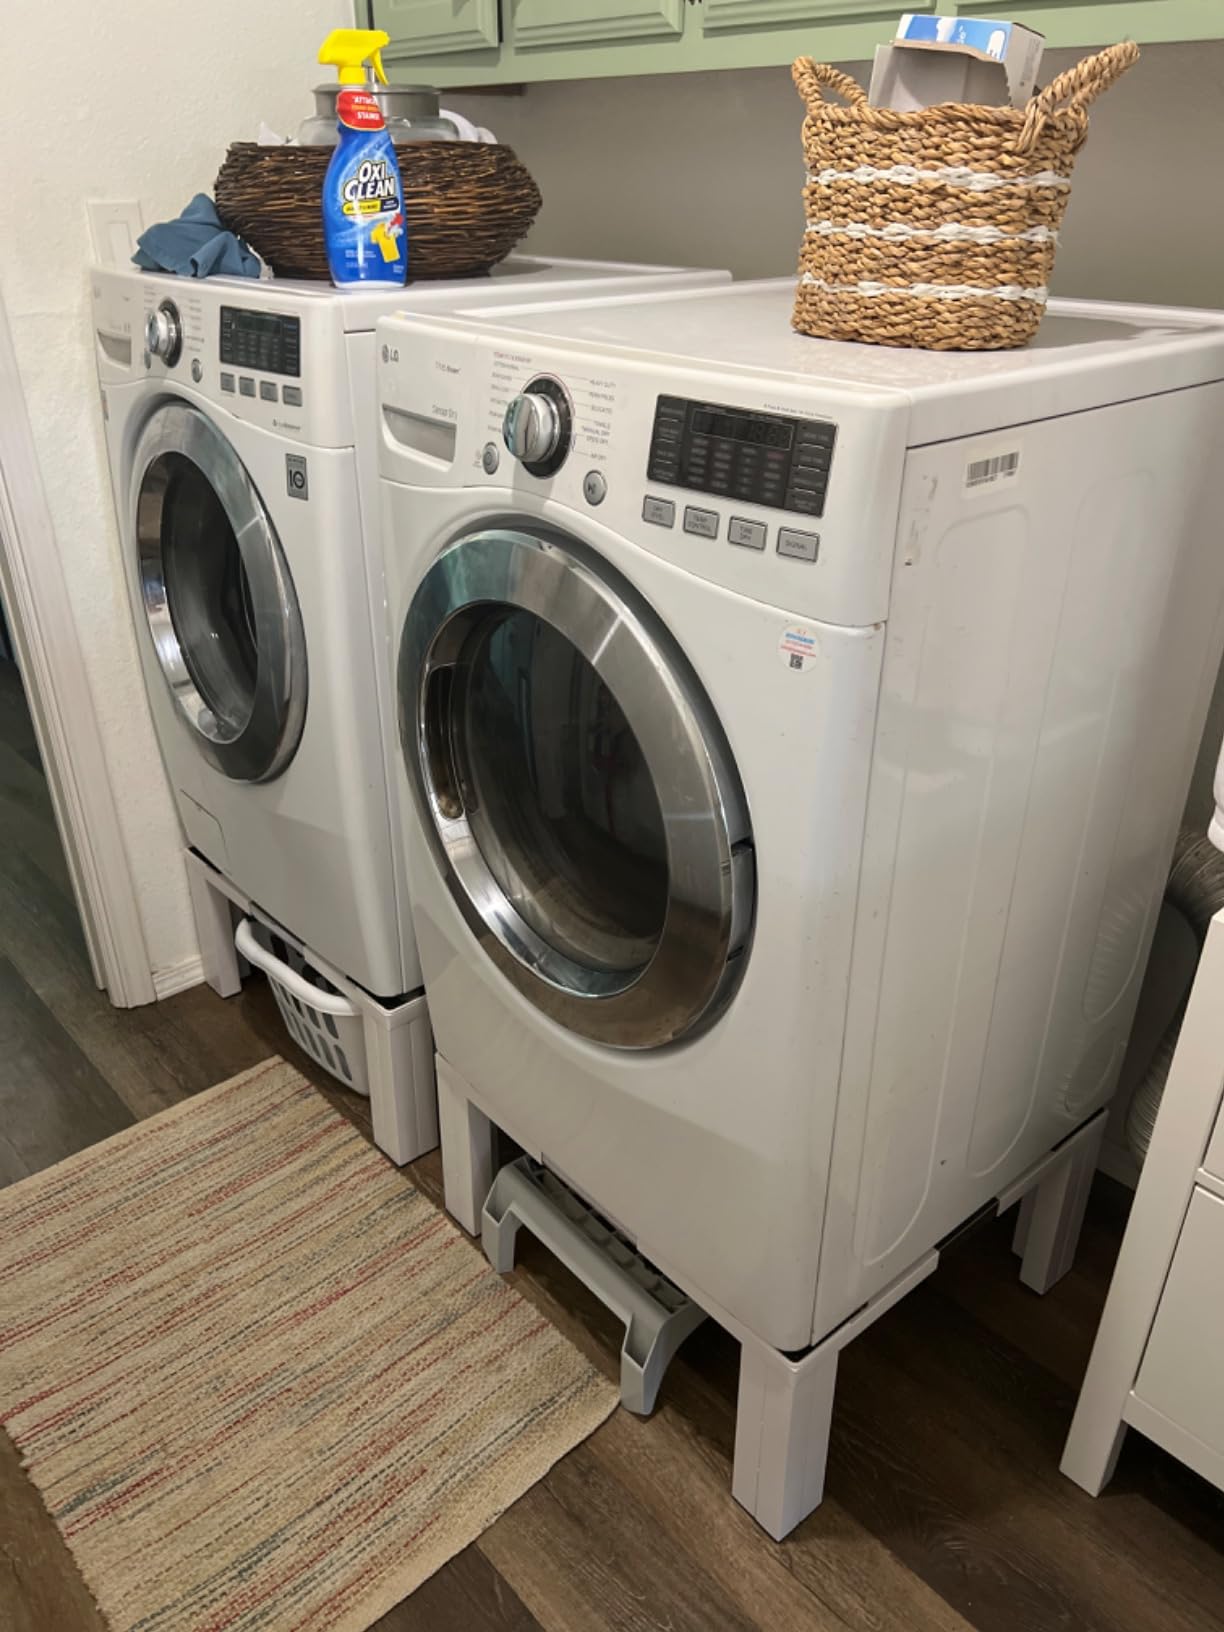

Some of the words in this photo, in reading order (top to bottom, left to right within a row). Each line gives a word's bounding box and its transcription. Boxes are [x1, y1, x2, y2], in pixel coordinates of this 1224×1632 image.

[359, 160, 386, 182] OXI
[344, 177, 395, 201] CLEAN
[390, 349, 399, 362] LG
